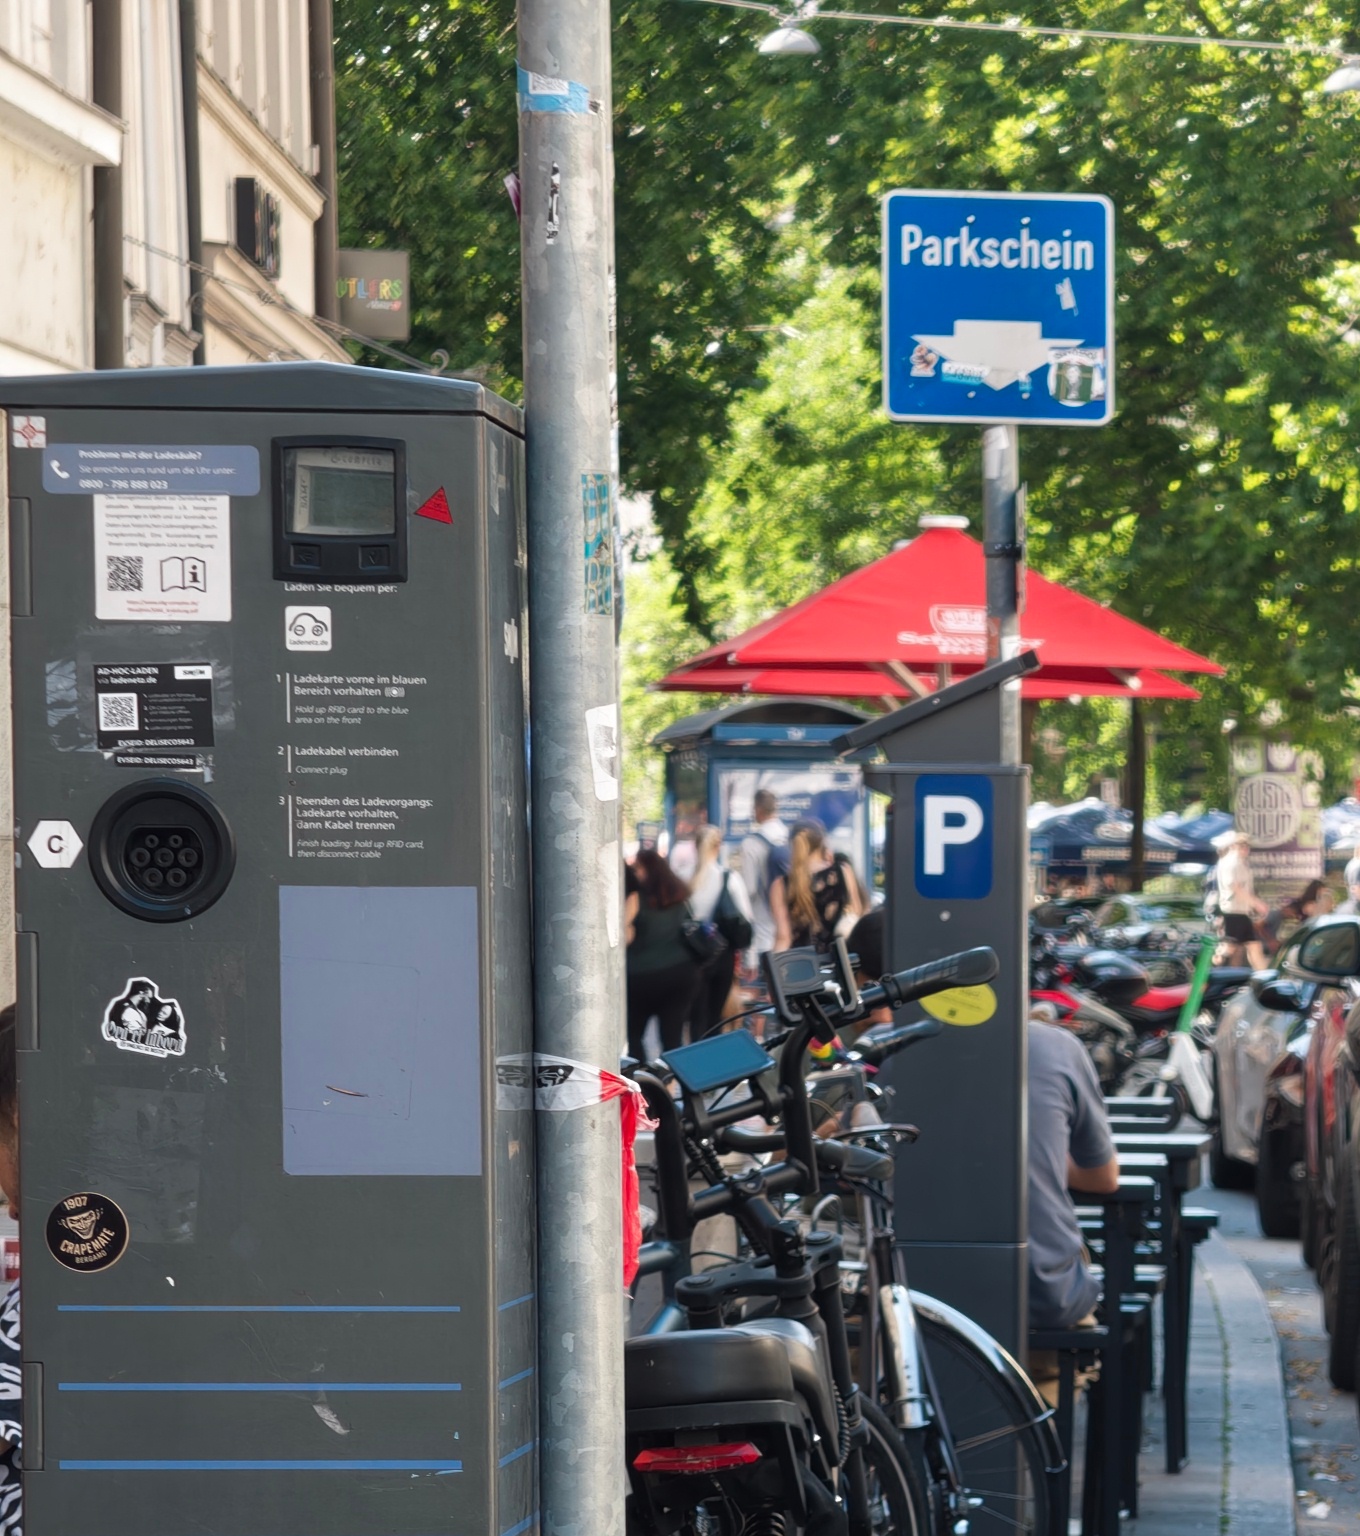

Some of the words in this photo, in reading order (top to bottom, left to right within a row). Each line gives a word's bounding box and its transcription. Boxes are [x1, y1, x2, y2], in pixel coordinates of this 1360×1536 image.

[901, 224, 1094, 271] Parkschein
[336, 277, 402, 299] UTLERS
[284, 583, 315, 592] Laden
[334, 584, 375, 594] bequem
[378, 585, 398, 594] per:
[276, 675, 281, 683] 1
[294, 674, 344, 684] Ladekarte
[346, 677, 375, 685] vorne
[377, 675, 389, 685] im
[392, 675, 427, 685] blauen
[294, 686, 332, 696] Bereich
[333, 687, 381, 696] vorhalten
[295, 705, 313, 714] Hold
[315, 707, 327, 717] up
[328, 706, 346, 714] RFID
[347, 706, 365, 715] card
[366, 707, 375, 715] to
[376, 706, 390, 715] the
[391, 706, 409, 715] blue
[326, 716, 340, 724] the
[341, 716, 361, 725] front
[277, 746, 284, 755] 2
[295, 746, 346, 756] Ladekabel
[348, 747, 399, 757] verbinden
[295, 766, 328, 774] Connect
[329, 766, 348, 776] plug
[278, 797, 285, 805] 3
[296, 797, 340, 806] Beenden
[342, 797, 358, 806] des
[361, 797, 433, 808] Ladevorgangs:
[296, 809, 346, 818] Ladekarte
[348, 809, 399, 820] vorhalten,
[297, 820, 322, 829] dann
[325, 820, 353, 830] Kabel
[355, 821, 395, 830] trennen
[924, 795, 984, 875] P
[47, 834, 63, 854] C
[297, 839, 319, 848] Finish
[321, 840, 351, 850] loading:
[354, 840, 372, 849] hold
[374, 842, 385, 851] up
[386, 841, 404, 849] RFID
[297, 850, 315, 858] then
[317, 850, 360, 859] disconnect
[361, 851, 381, 859] cable
[63, 1196, 88, 1211] 1907
[75, 1250, 107, 1263] BERGAMO
